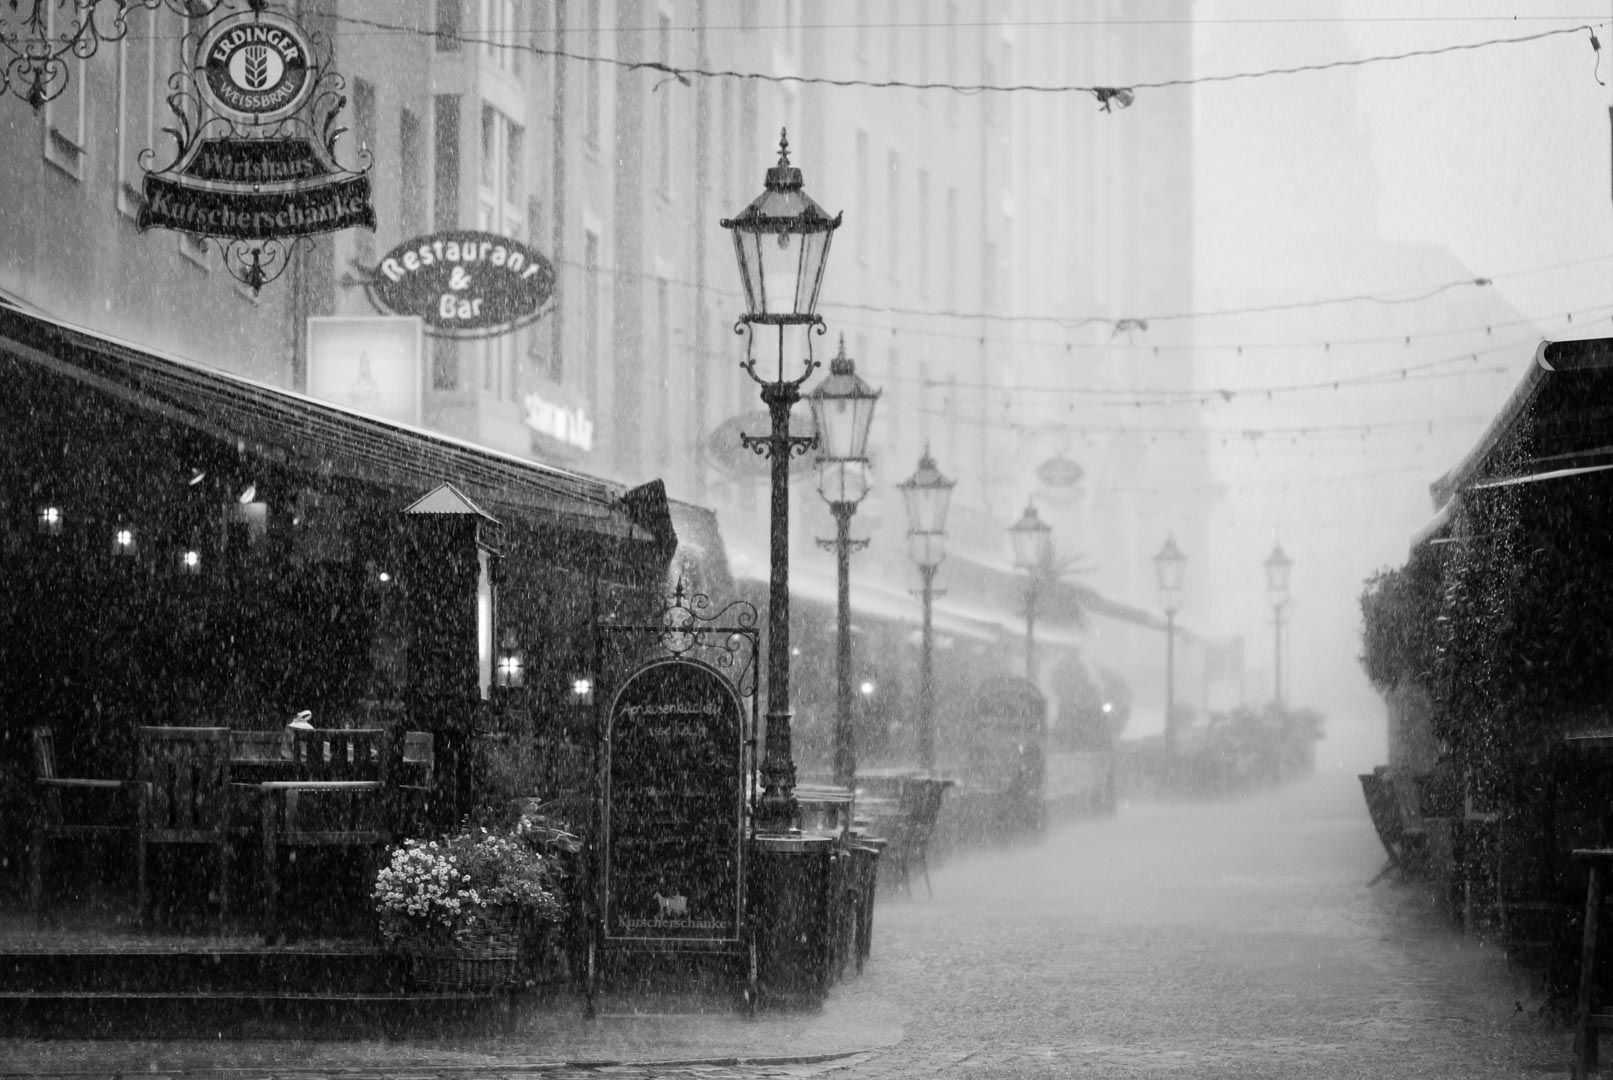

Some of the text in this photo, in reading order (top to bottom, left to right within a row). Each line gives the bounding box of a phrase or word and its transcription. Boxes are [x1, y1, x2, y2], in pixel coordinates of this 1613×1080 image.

[213, 28, 298, 61] ERDINGER
[203, 153, 313, 179] Wirtshaus
[150, 191, 364, 228] Kutscherschänke
[382, 240, 540, 282] Restaurant
[449, 266, 472, 290] &
[439, 293, 483, 319] Bar
